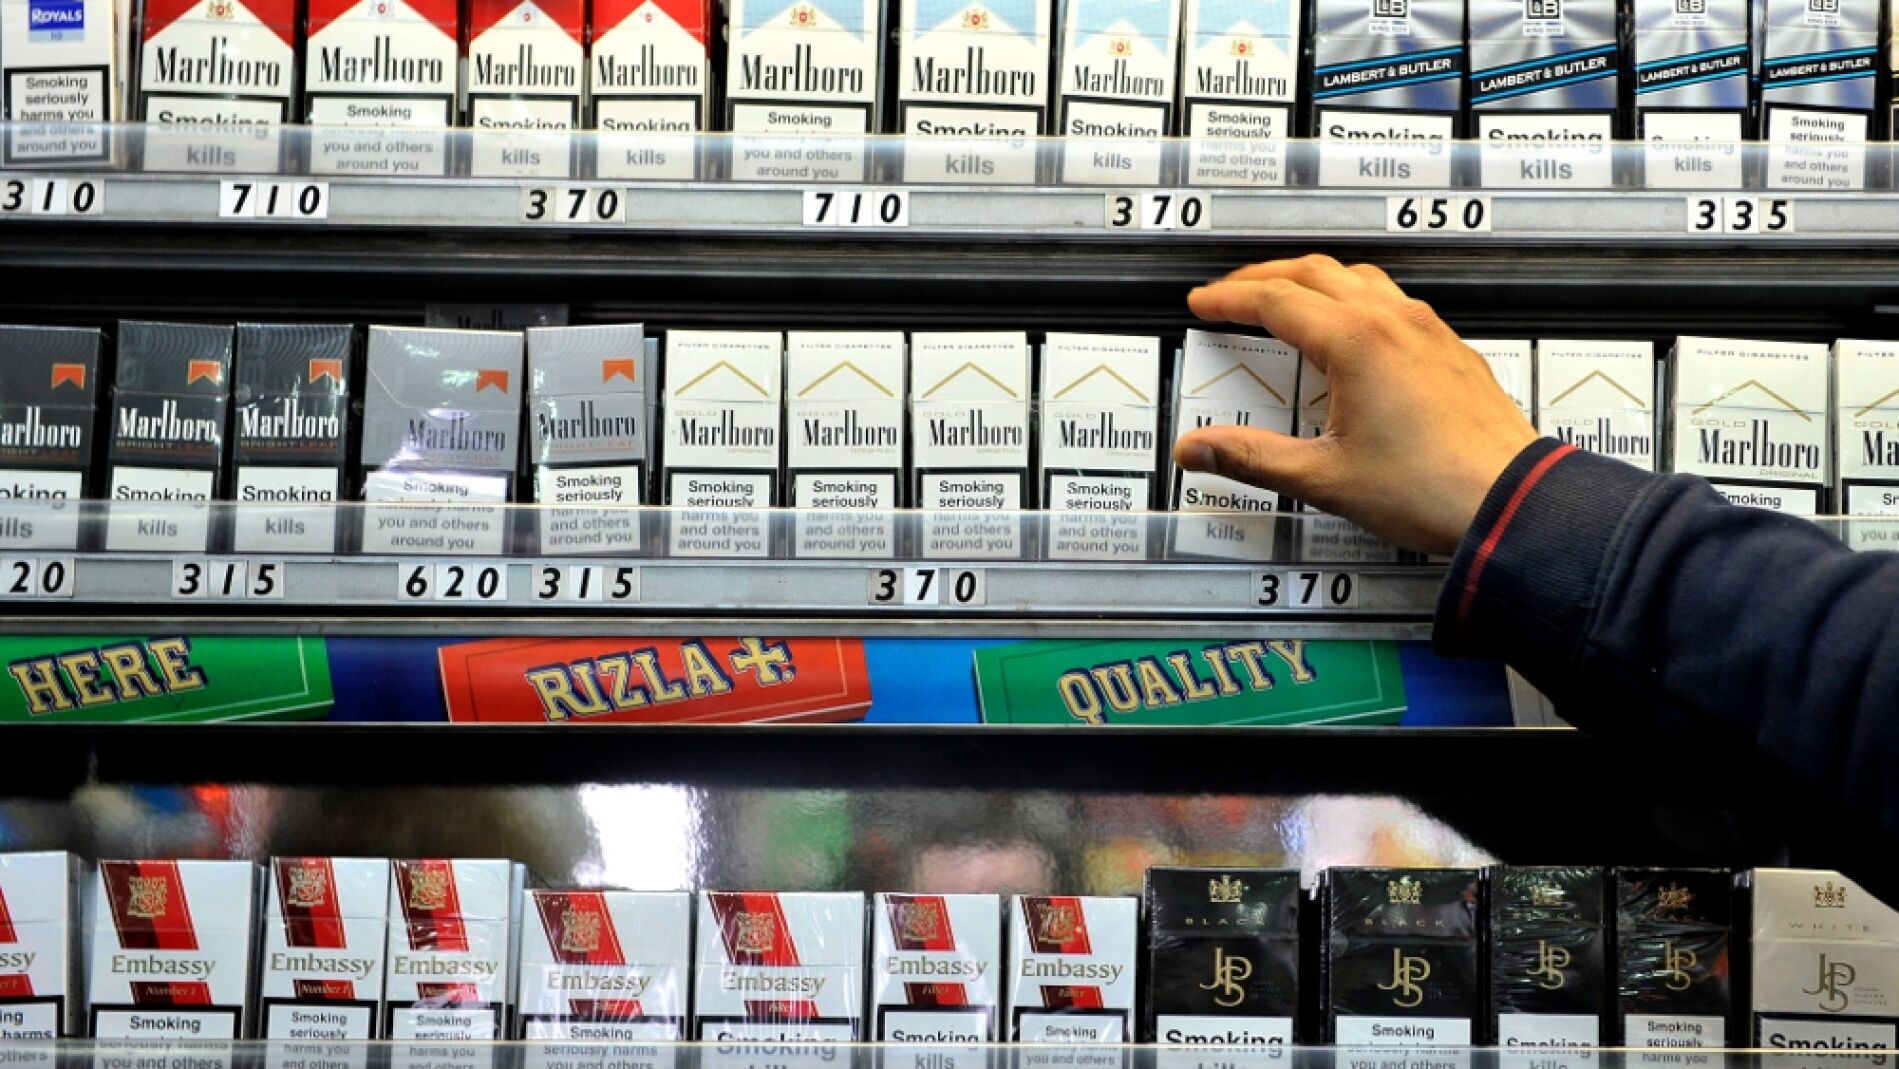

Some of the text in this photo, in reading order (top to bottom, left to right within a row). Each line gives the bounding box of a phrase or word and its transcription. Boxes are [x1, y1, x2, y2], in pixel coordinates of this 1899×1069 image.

[31, 9, 83, 23] ROYALS
[154, 36, 281, 88] Marlboro
[319, 35, 444, 83] Marlboro
[474, 43, 576, 87] Marlboro
[596, 43, 699, 87] Marlboro
[739, 43, 864, 94] Marlboro
[1769, 63, 1818, 80] LAMBERT
[1828, 56, 1872, 73] BUTLER
[911, 45, 1036, 98] Marlboro
[1072, 58, 1165, 97] Marlboro
[1195, 59, 1287, 97] Marlboro
[1323, 65, 1386, 88] LAMBERT
[1399, 57, 1452, 77] BUTLER
[1480, 69, 1542, 93] LAMBERT
[1554, 56, 1608, 77] BUTLER
[1640, 64, 1690, 84] LAMBERT
[1699, 55, 1741, 73] BUTLER
[25, 75, 89, 90] Smoking
[25, 91, 89, 106] seriously
[20, 107, 94, 122] harms you
[346, 105, 412, 121] Smoking
[767, 111, 833, 128] Smoking
[1206, 110, 1272, 127] Smoking
[1070, 119, 1158, 143] Smoking
[1205, 126, 1273, 139] seriously
[1791, 115, 1846, 132] Smoking
[16, 140, 98, 155] around you
[186, 145, 237, 167] kills
[501, 148, 541, 166] kills
[626, 149, 666, 166] kills
[336, 158, 420, 172] around you
[945, 153, 995, 176] kills
[1092, 151, 1132, 170] kills
[1358, 156, 1412, 180] kills
[1519, 159, 1574, 180] kills
[1673, 155, 1713, 173] kills
[756, 166, 839, 181] around you
[1195, 167, 1278, 183] around you
[1779, 173, 1851, 189] around you
[232, 184, 321, 216] 710
[525, 188, 618, 220] 370
[815, 193, 902, 224] 710
[1111, 195, 1202, 228] 370
[1396, 197, 1484, 230] 650
[1695, 199, 1789, 232] 335
[0, 405, 82, 448] arlboro
[117, 399, 217, 442] Marlboro
[240, 397, 340, 439] Marlboro
[538, 400, 636, 442] Marlboro
[680, 409, 775, 447] Marlboro
[803, 409, 898, 447] Marlboro
[1690, 418, 1746, 429] GOLD
[407, 412, 507, 453] Marlboro
[928, 409, 1023, 448] Marlboro
[1058, 411, 1153, 452] Marlboro
[1556, 417, 1649, 457] Marlboro
[1697, 419, 1821, 471] Marlboro
[556, 474, 623, 491] Smoking
[688, 480, 755, 497] Smoking
[812, 480, 879, 497] Smoking
[939, 480, 1005, 497] Smoking
[1065, 481, 1132, 501] Smoking
[116, 485, 207, 510] Smoking
[242, 485, 333, 504] Smoking
[555, 489, 624, 503] seriously
[687, 496, 756, 509] seriously
[812, 496, 880, 509] seriously
[939, 496, 1006, 511] seriously
[1065, 497, 1133, 512] seriously
[137, 518, 178, 537] kills
[264, 517, 306, 536] kills
[378, 515, 490, 533] you and others
[679, 525, 760, 538] and others
[805, 525, 885, 538] and others
[931, 525, 1011, 538] and others
[1205, 522, 1246, 542] kills
[390, 534, 475, 551] around you
[549, 532, 633, 548] around you
[1058, 528, 1138, 542] and others
[677, 539, 762, 554] around you
[803, 538, 887, 554] around you
[929, 538, 1014, 554] around you
[1056, 541, 1140, 558] around you
[179, 563, 276, 597] 315
[406, 565, 500, 599] 620
[539, 567, 634, 601] 315
[875, 569, 977, 604] 370
[1258, 573, 1353, 606] 370
[7, 637, 209, 716] HERE
[1057, 640, 1317, 724] QUALITY
[111, 955, 217, 981] Embassy
[270, 953, 376, 981] Embassy
[393, 955, 499, 981] Embassy
[887, 955, 989, 982] Embassy
[1020, 958, 1124, 986] Embassy
[145, 985, 190, 997] Number
[300, 984, 344, 996] Number
[546, 970, 651, 998] Embassy
[722, 970, 827, 998] Embassy
[129, 1015, 202, 1033] Smoking
[291, 1011, 348, 1026] Smoking
[416, 1015, 472, 1029] Smoking
[1647, 1020, 1703, 1036] Smoking
[289, 1028, 348, 1041] seriously
[570, 1025, 633, 1041] Smoking
[892, 1029, 979, 1051] Smoking
[1371, 1022, 1435, 1040] Smoking
[1165, 1029, 1284, 1059] Smoking
[1768, 1032, 1887, 1066] Smoking
[913, 1053, 956, 1069] kills
